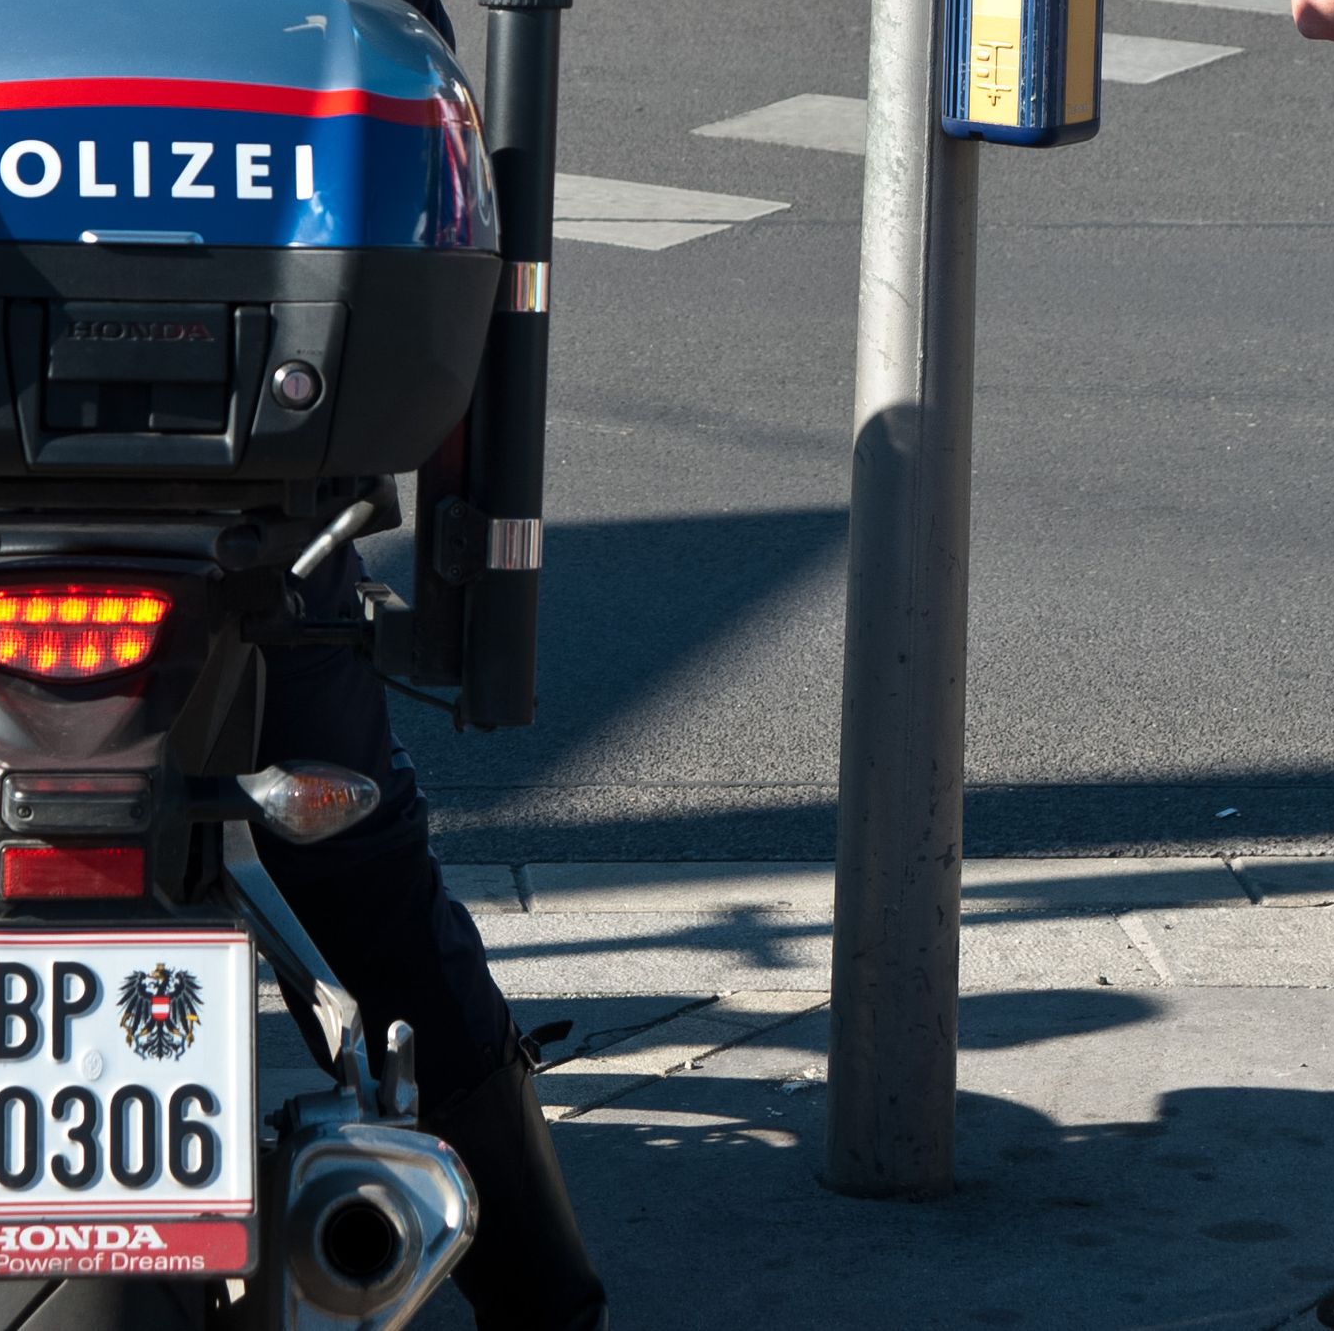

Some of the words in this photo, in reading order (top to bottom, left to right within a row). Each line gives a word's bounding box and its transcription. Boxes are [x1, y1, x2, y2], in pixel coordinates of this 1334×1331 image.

[67, 320, 215, 343] HONDA
[78, 1251, 104, 1273] of
[111, 1253, 205, 1273] Dreams
